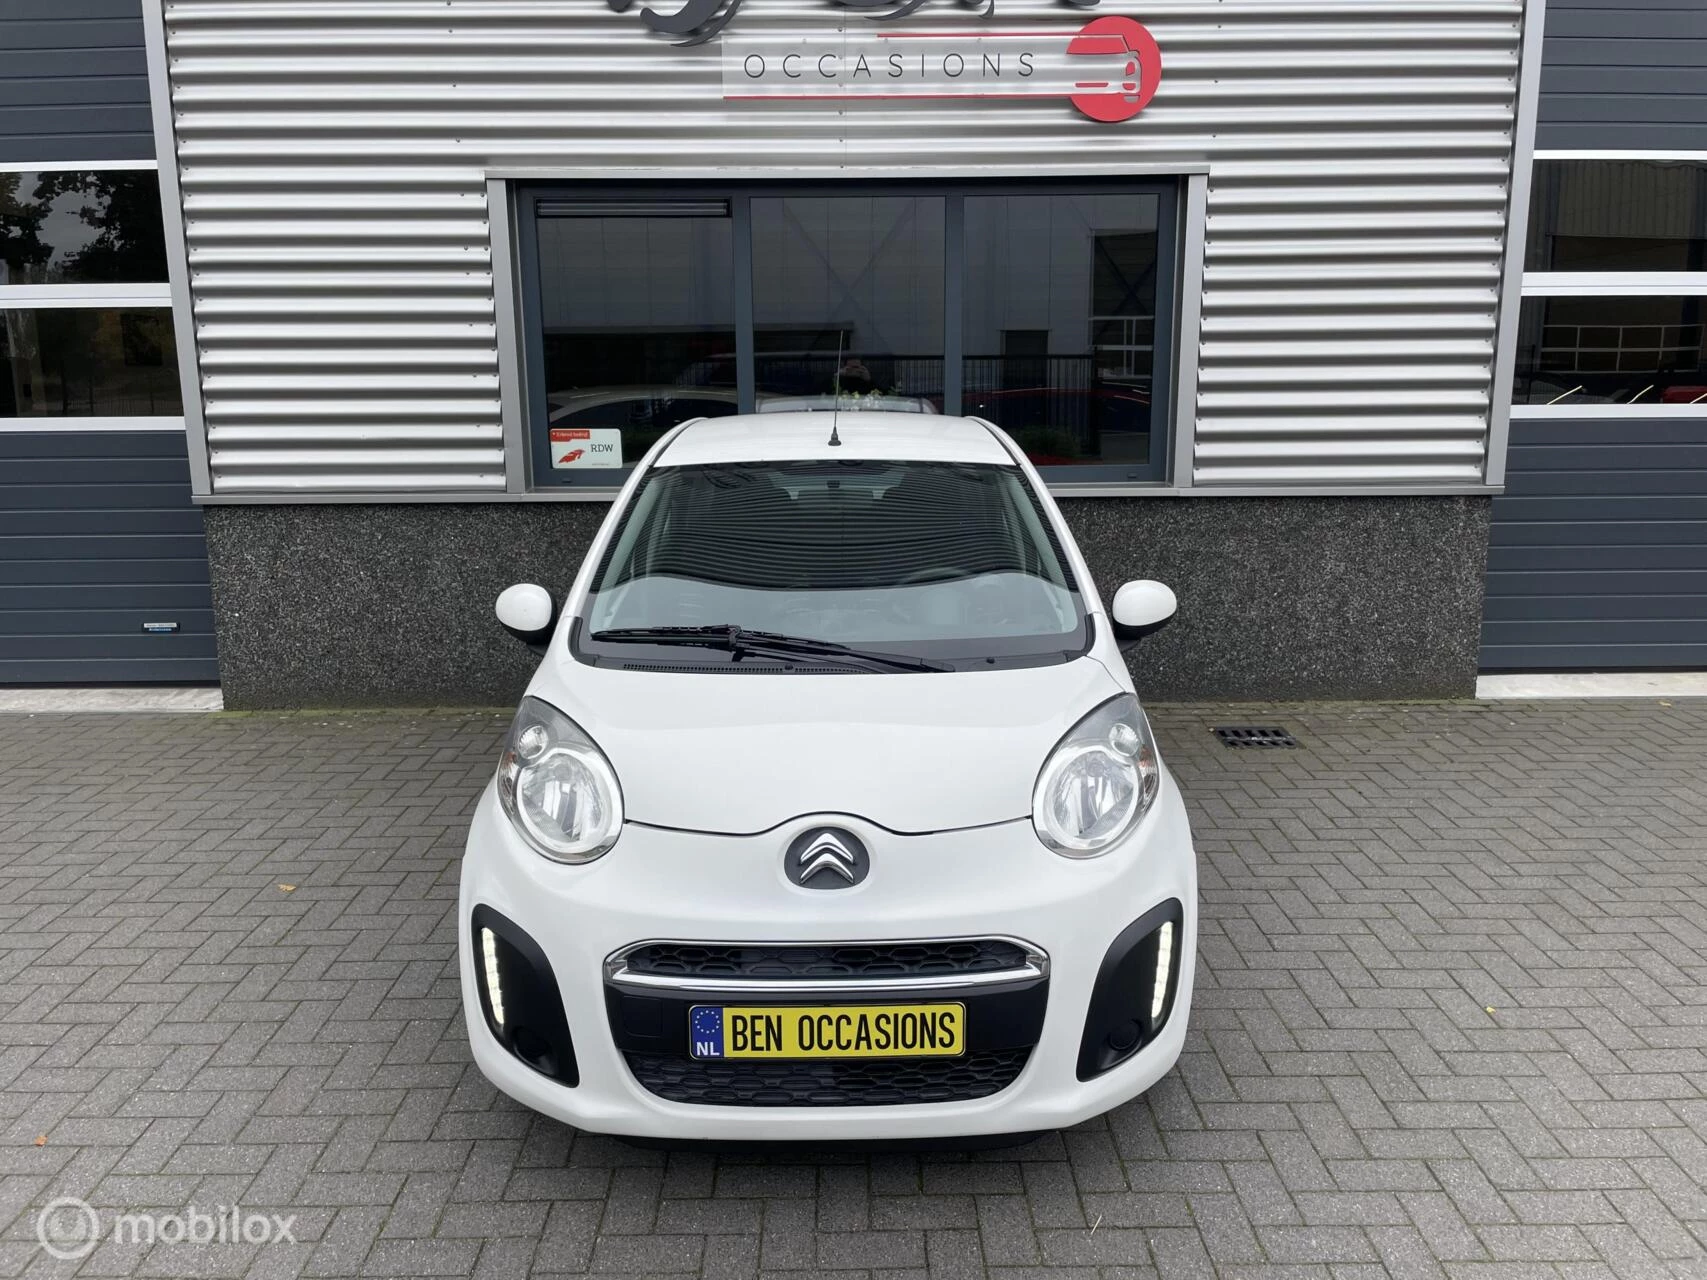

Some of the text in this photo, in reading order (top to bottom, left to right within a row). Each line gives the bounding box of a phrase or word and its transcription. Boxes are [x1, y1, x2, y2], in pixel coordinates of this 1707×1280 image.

[743, 53, 1035, 79] OCCASIONS
[591, 444, 614, 453] RDW
[731, 1012, 956, 1051] BEN OCCASIONS
[696, 1041, 720, 1056] NL
